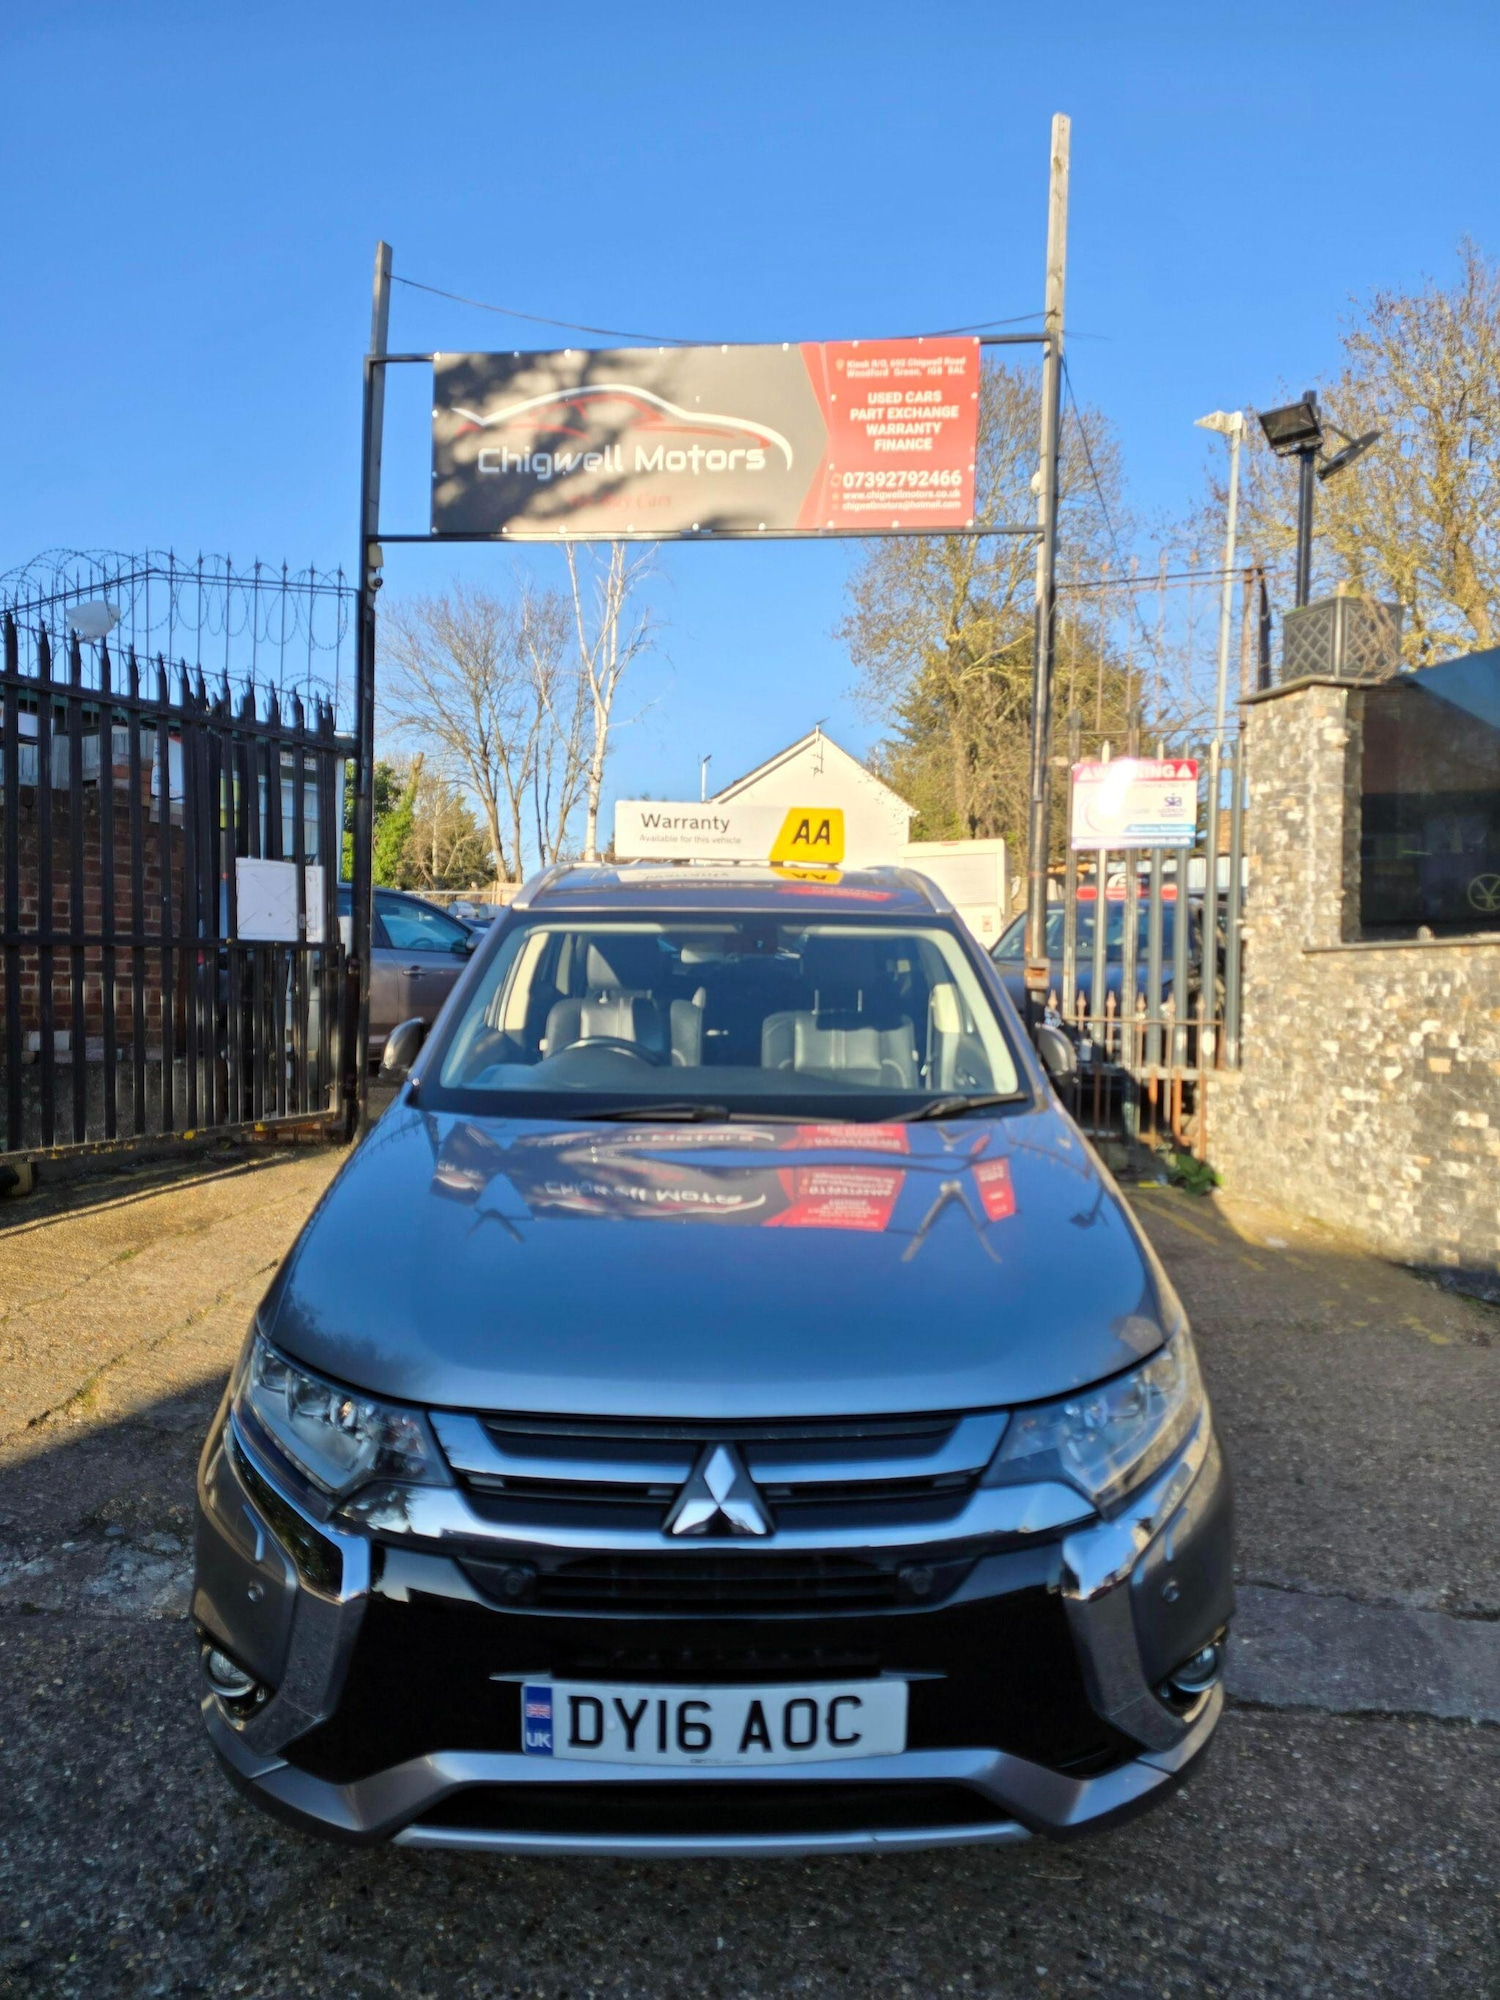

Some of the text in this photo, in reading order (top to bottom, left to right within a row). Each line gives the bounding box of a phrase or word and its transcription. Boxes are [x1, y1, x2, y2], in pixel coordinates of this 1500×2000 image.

[847, 359, 869, 369] Kiosk
[907, 356, 943, 368] Chigwell
[944, 356, 966, 366] Road
[847, 368, 889, 378] Woodford
[893, 368, 922, 377] Green,
[867, 390, 943, 405] USED CARS
[850, 405, 960, 421] PART EXCHANGE
[866, 421, 943, 436] WARRANTY
[874, 437, 933, 452] FINANCE
[477, 444, 766, 480] Chigwell Motors
[842, 469, 963, 488] 07392792466
[842, 488, 961, 501] www.chigwellmotors.co.uk
[842, 500, 961, 512] chigwellmotors@hotmail.com
[641, 813, 730, 833] Warranty
[640, 833, 742, 845] Available for this vehicle
[791, 818, 831, 845] AA
[567, 1695, 863, 1754] DY16 AOC
[526, 1731, 552, 1749] UK
